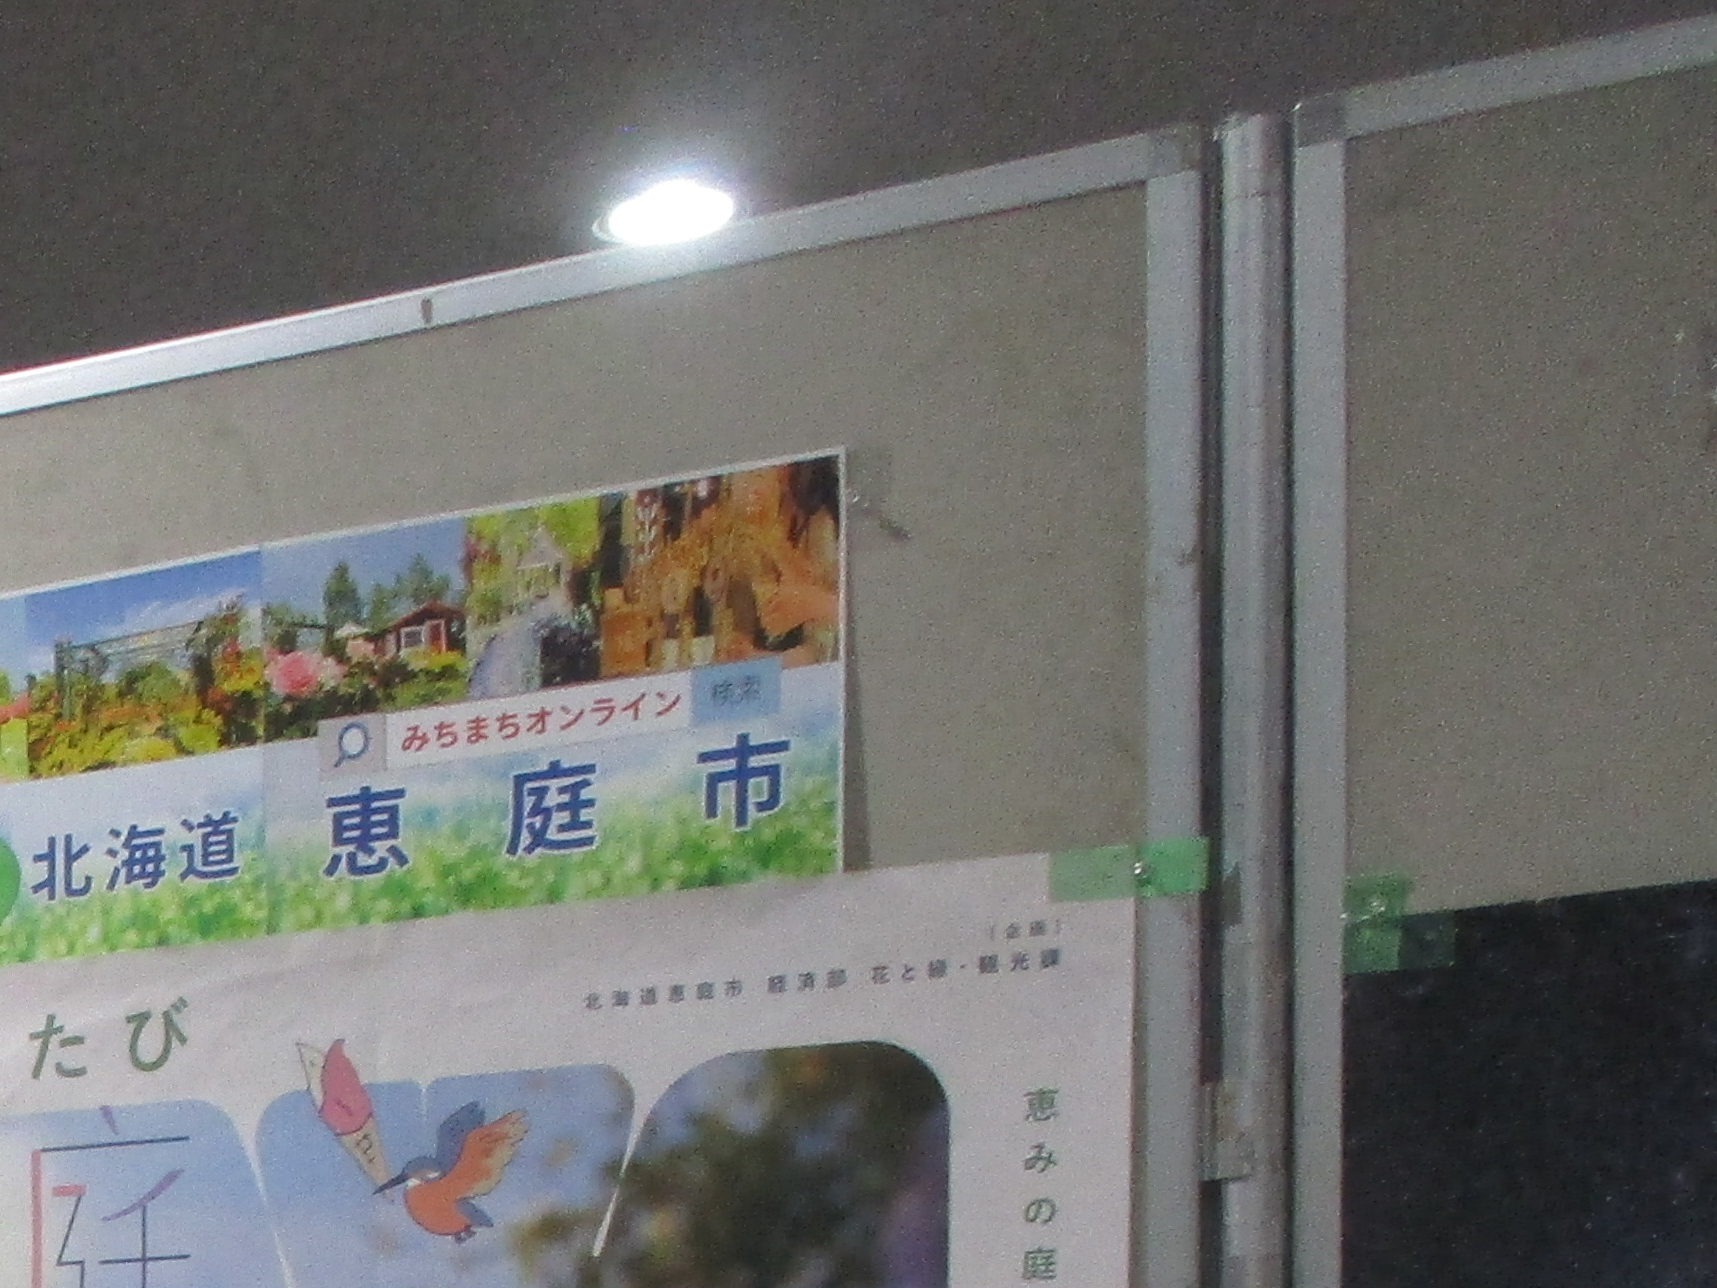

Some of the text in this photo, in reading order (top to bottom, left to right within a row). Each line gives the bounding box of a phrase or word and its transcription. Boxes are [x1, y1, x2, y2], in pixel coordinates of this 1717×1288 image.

[401, 690, 682, 753] みちまちオンライン
[30, 732, 793, 903] 北海道 恵庭市
